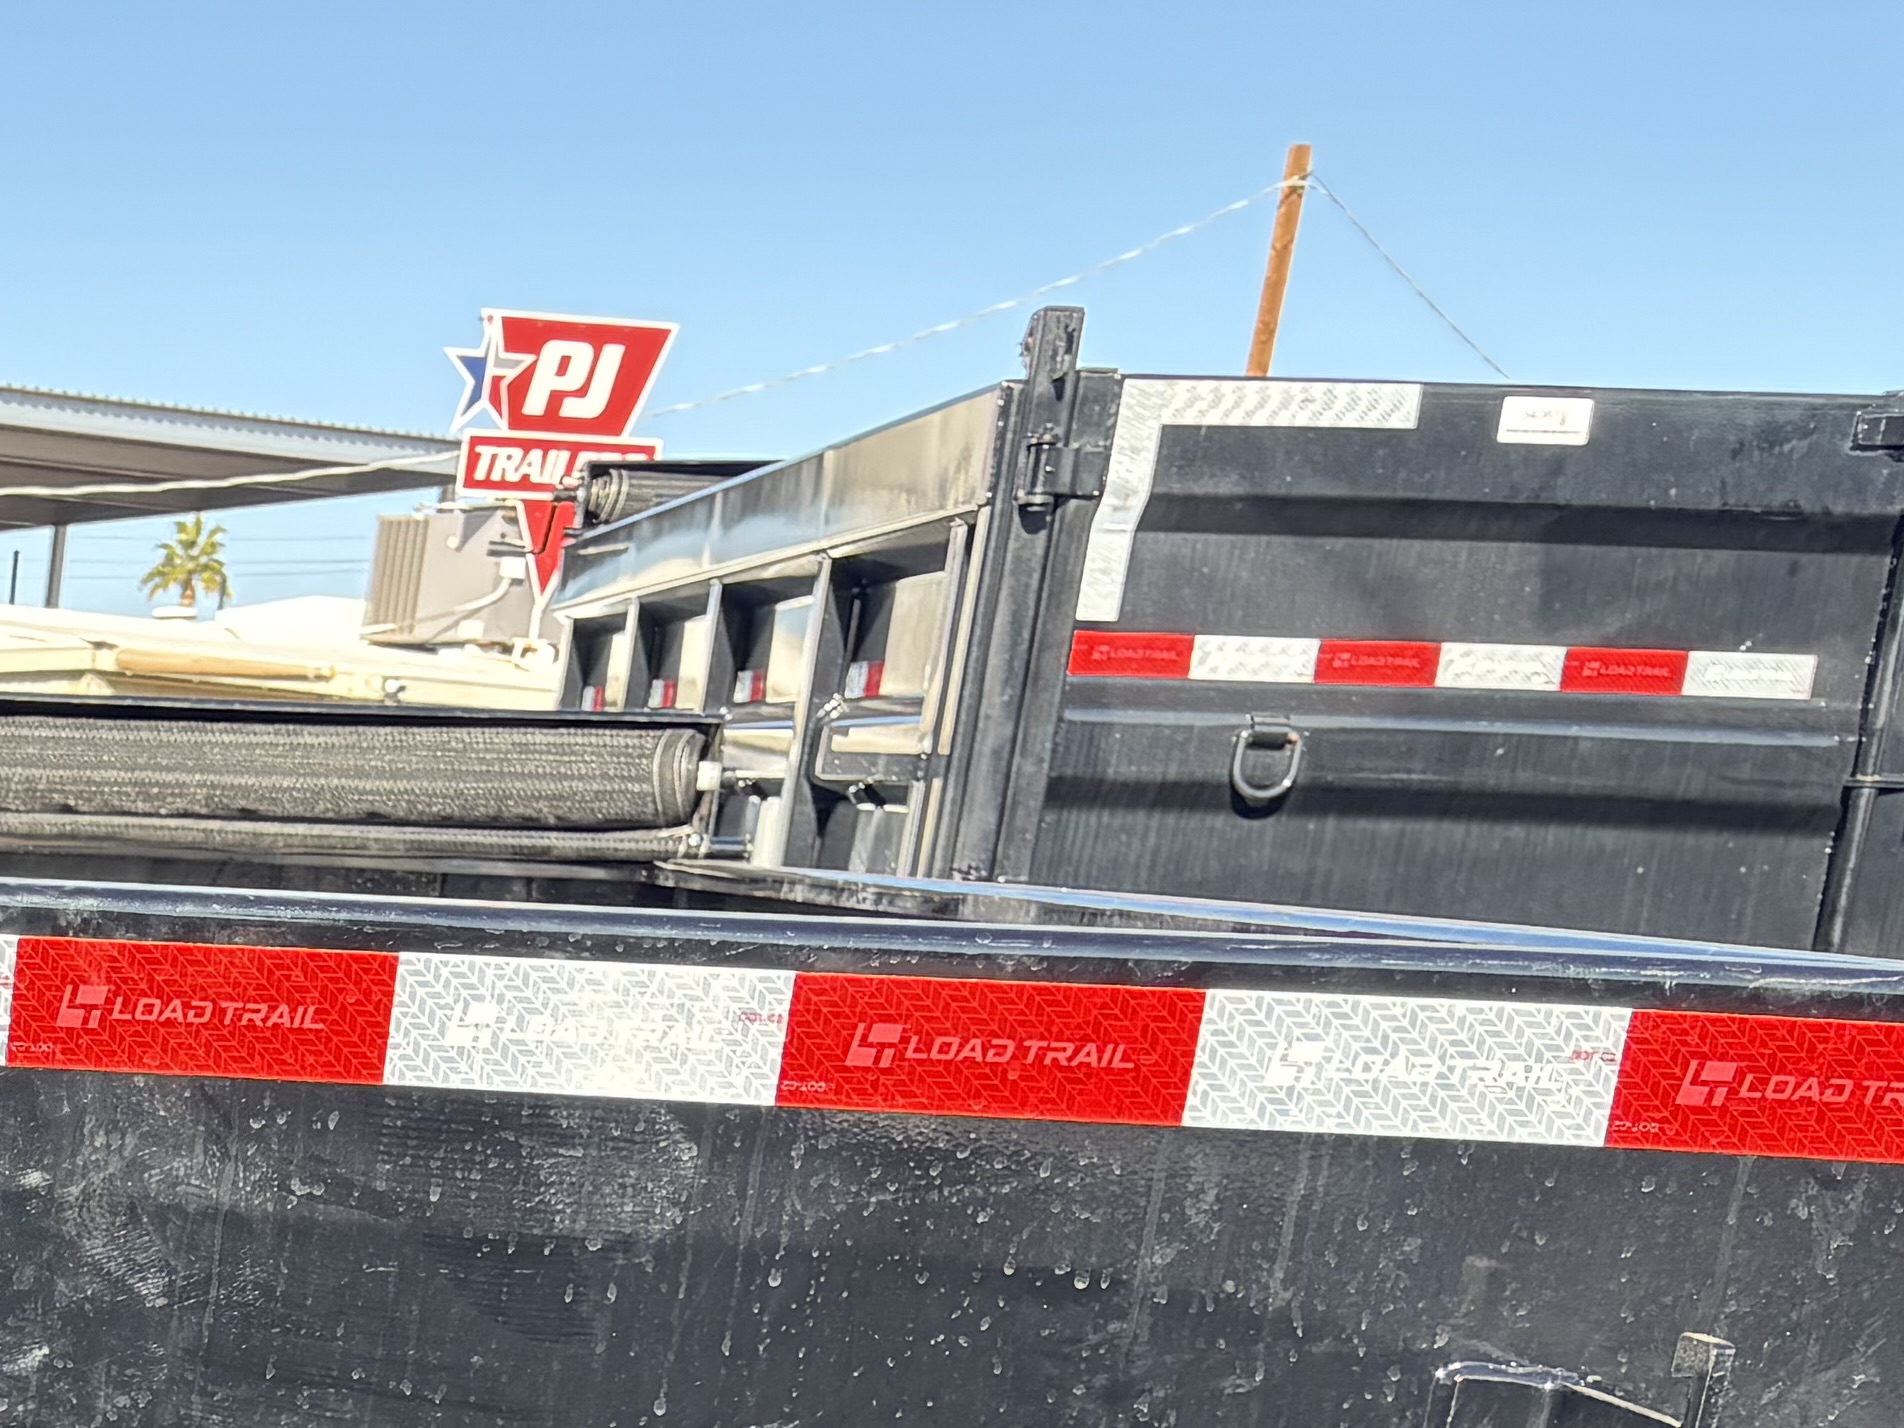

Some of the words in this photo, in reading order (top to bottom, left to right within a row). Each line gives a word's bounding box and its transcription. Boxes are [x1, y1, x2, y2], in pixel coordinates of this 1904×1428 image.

[521, 339, 627, 419] PJ
[111, 996, 213, 1025] LOAD
[220, 1001, 326, 1029] TRAIL
[905, 1034, 1016, 1064] LOAD
[1021, 1038, 1136, 1070] TRAIL
[1738, 1072, 1855, 1103] LOAD
[1862, 1077, 1904, 1108] TR
